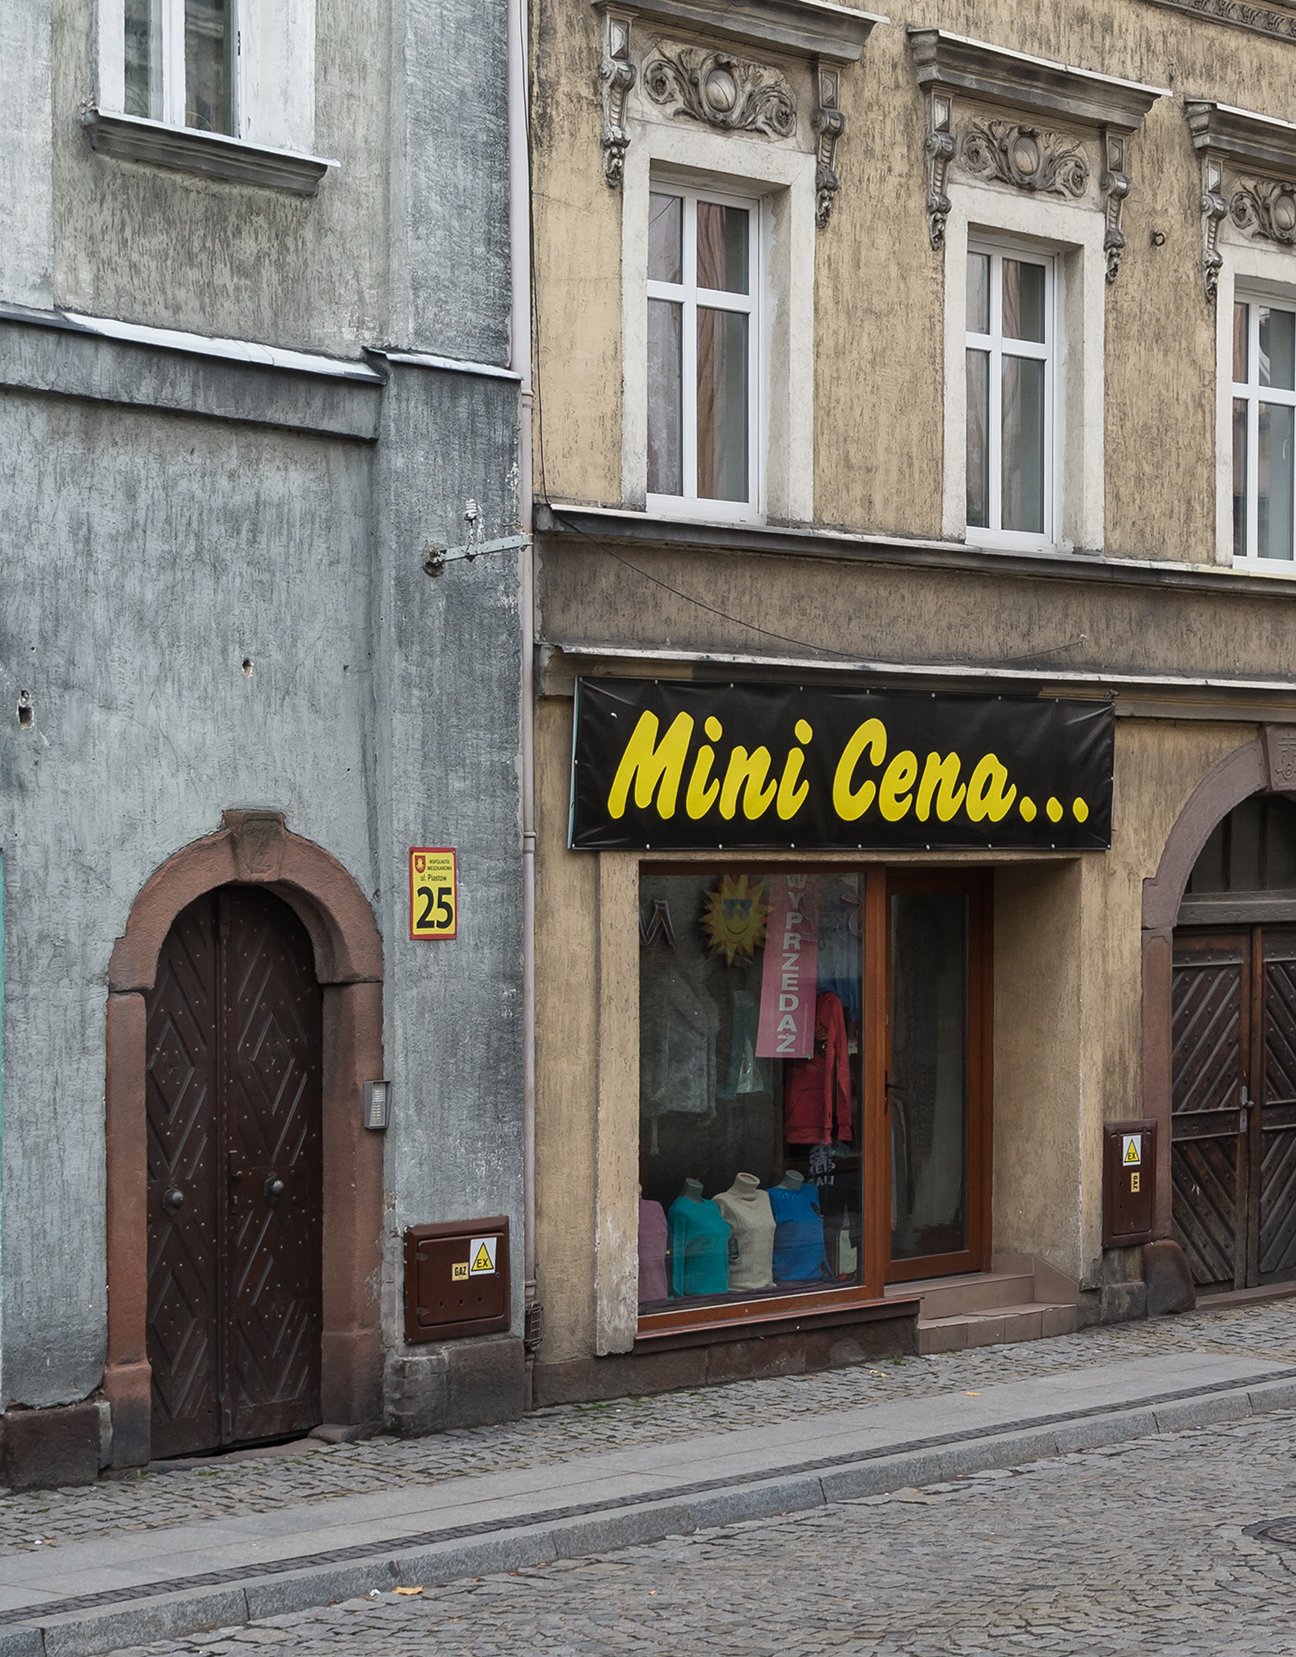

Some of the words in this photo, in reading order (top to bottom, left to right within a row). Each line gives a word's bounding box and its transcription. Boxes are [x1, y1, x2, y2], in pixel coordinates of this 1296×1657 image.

[606, 709, 813, 822] Mini
[416, 886, 454, 930] 25
[1128, 1151, 1137, 1161] EX
[476, 1258, 489, 1269] EX
[454, 1266, 467, 1277] GAZ
